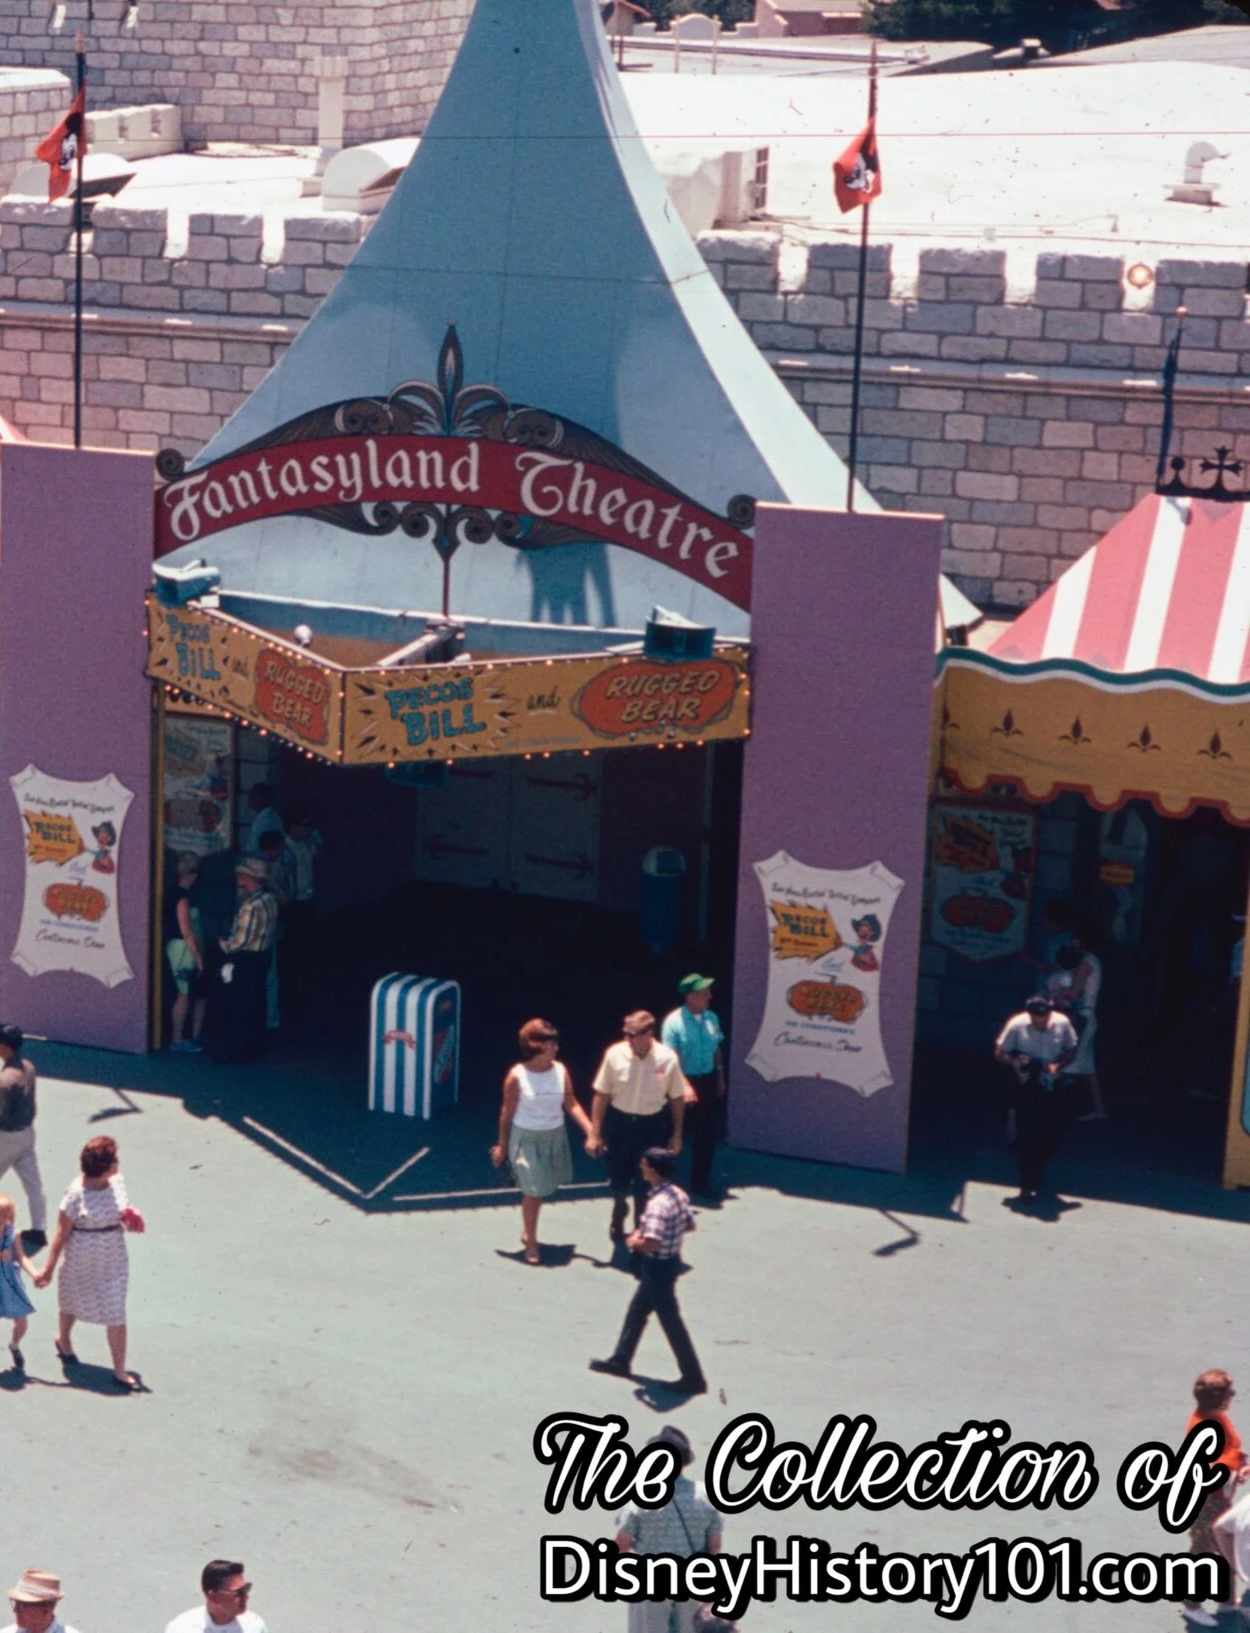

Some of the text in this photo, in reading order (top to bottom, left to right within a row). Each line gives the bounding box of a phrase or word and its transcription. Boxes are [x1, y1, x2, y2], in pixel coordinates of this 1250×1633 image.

[163, 439, 740, 578] Fantasyland Theatre
[176, 642, 221, 681] BILL
[265, 659, 326, 705] RUGGED
[384, 676, 474, 720] PECOS
[527, 685, 561, 711] and
[605, 669, 721, 700] RUGGED
[271, 690, 314, 728] BEAR
[400, 703, 487, 747] BILL
[620, 697, 702, 723] BEAR
